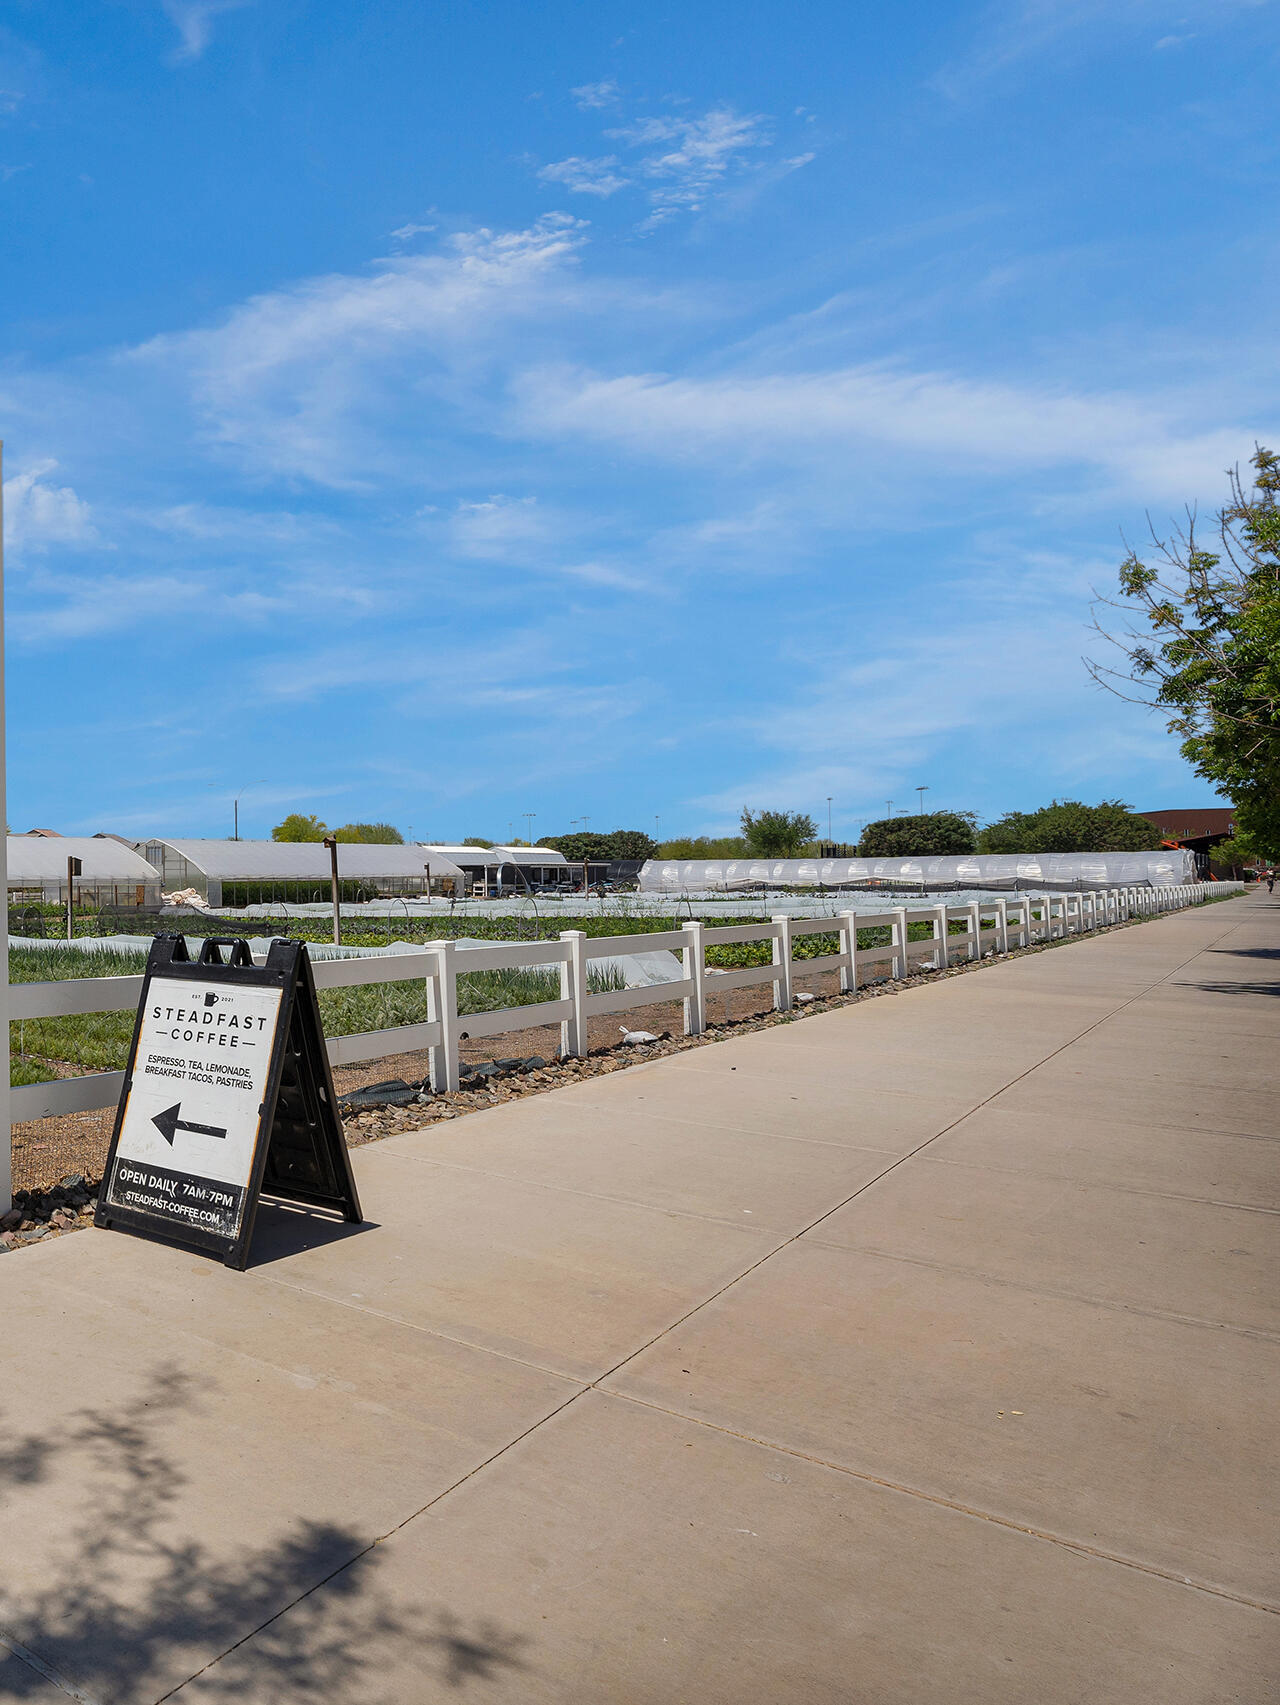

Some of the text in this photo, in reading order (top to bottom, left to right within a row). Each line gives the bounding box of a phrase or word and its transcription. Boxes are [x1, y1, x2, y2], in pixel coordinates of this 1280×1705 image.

[152, 1006, 267, 1031] STEADFAST
[171, 1028, 239, 1048] COFFEE
[144, 1065, 254, 1090] BREAKFAST TACOS, PASTRIES
[147, 1054, 252, 1079] ESPRESSO, TEA, LEMONADE,
[119, 1168, 234, 1208] OPEN DAILY 7AM-7PM
[125, 1190, 221, 1224] STEADFAST-COFFEE.COM
